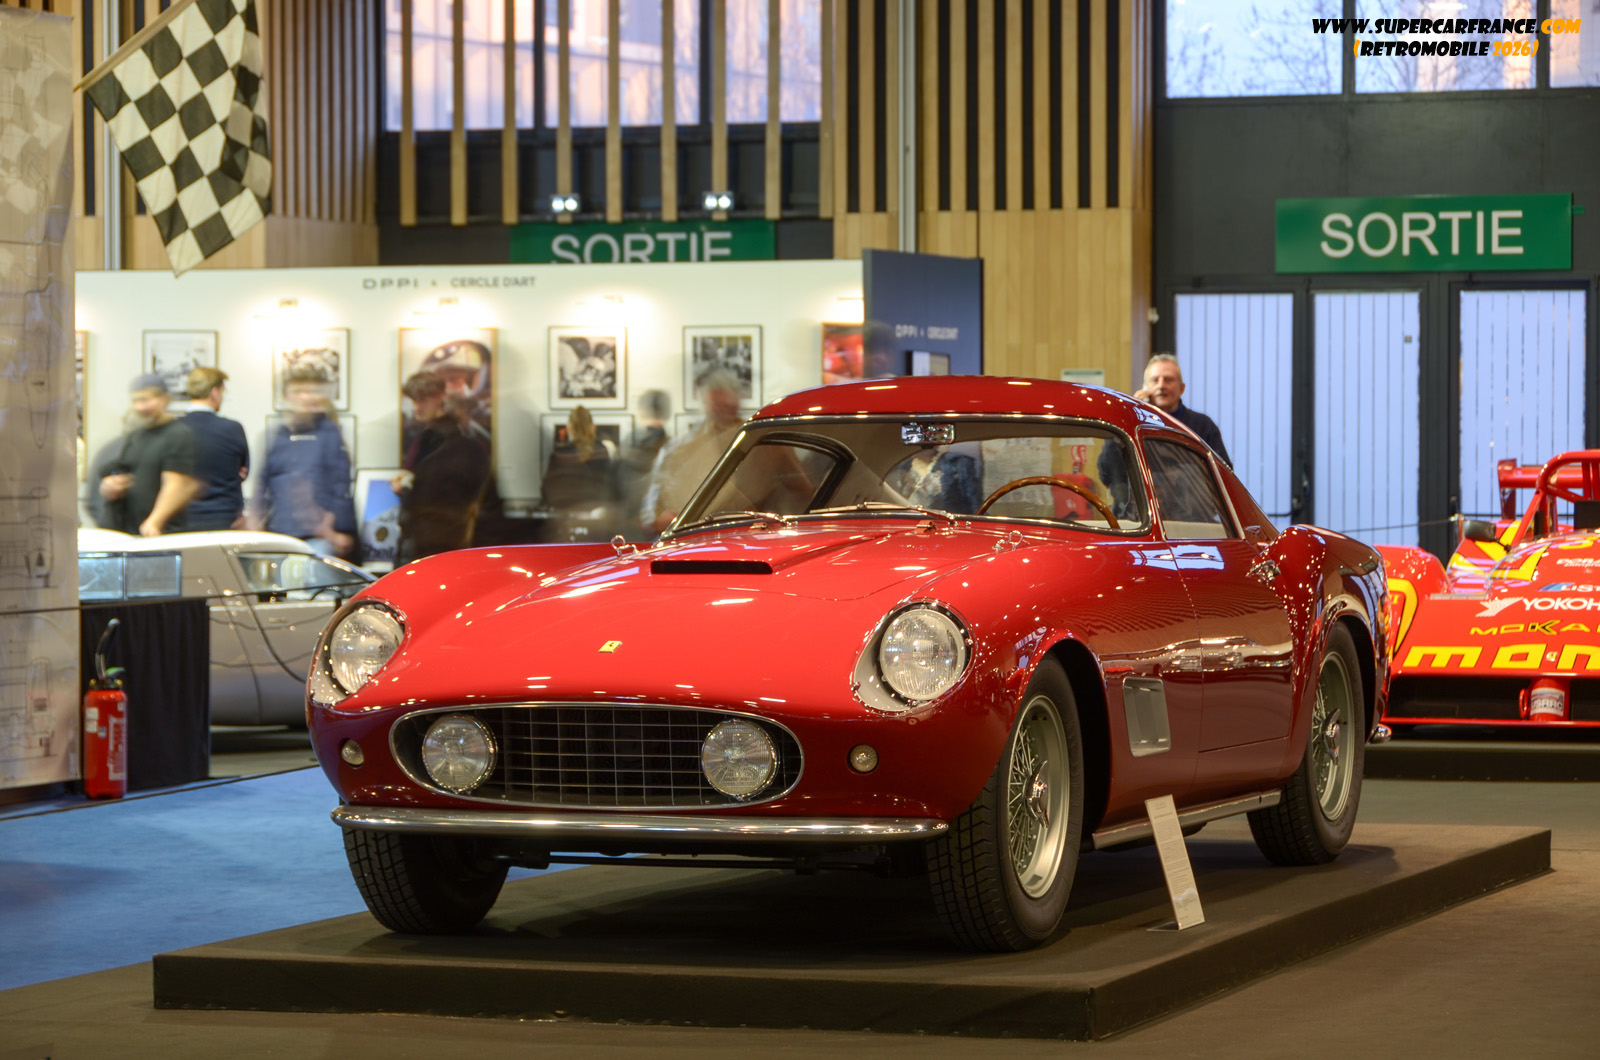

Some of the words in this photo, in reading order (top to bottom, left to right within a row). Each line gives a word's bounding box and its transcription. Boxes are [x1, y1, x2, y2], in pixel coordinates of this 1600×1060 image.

[1320, 210, 1524, 258] SORTIE
[363, 278, 418, 289] DPPI
[450, 276, 498, 288] CERCLE
[503, 276, 536, 287] D'ART
[1469, 619, 1600, 635] MOKA
